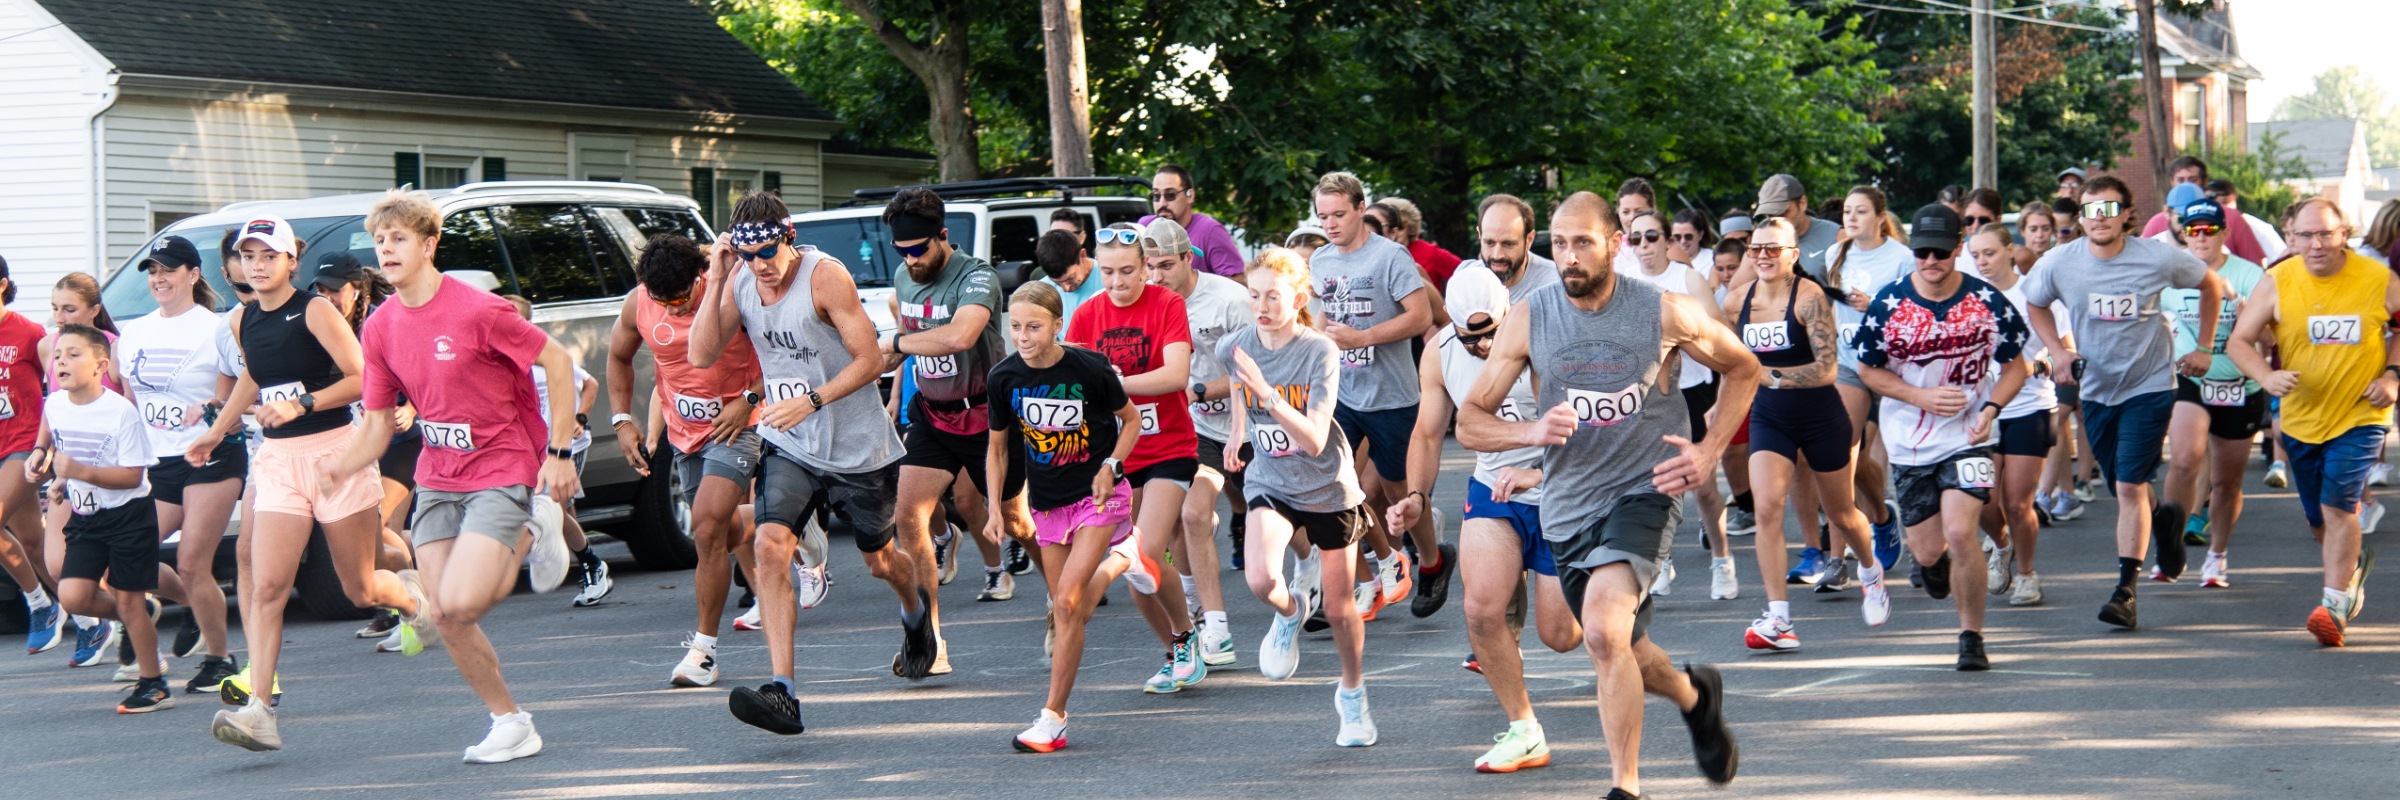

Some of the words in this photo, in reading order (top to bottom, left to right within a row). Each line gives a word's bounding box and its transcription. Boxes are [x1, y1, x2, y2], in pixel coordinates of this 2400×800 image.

[1345, 301, 1372, 314] FIELD
[2094, 298, 2133, 317] 112
[1103, 336, 1143, 346] DRAGONS
[1746, 325, 1786, 349] 095
[2311, 319, 2357, 341] 027
[1888, 326, 1999, 360] Bastards
[1948, 353, 1990, 386] 420
[2203, 383, 2242, 402] 069
[145, 402, 183, 428] 043
[678, 398, 721, 420] 063
[1026, 402, 1080, 427] 072
[1573, 392, 1637, 423] 060
[424, 424, 470, 449] 078
[1258, 429, 1290, 453] 09
